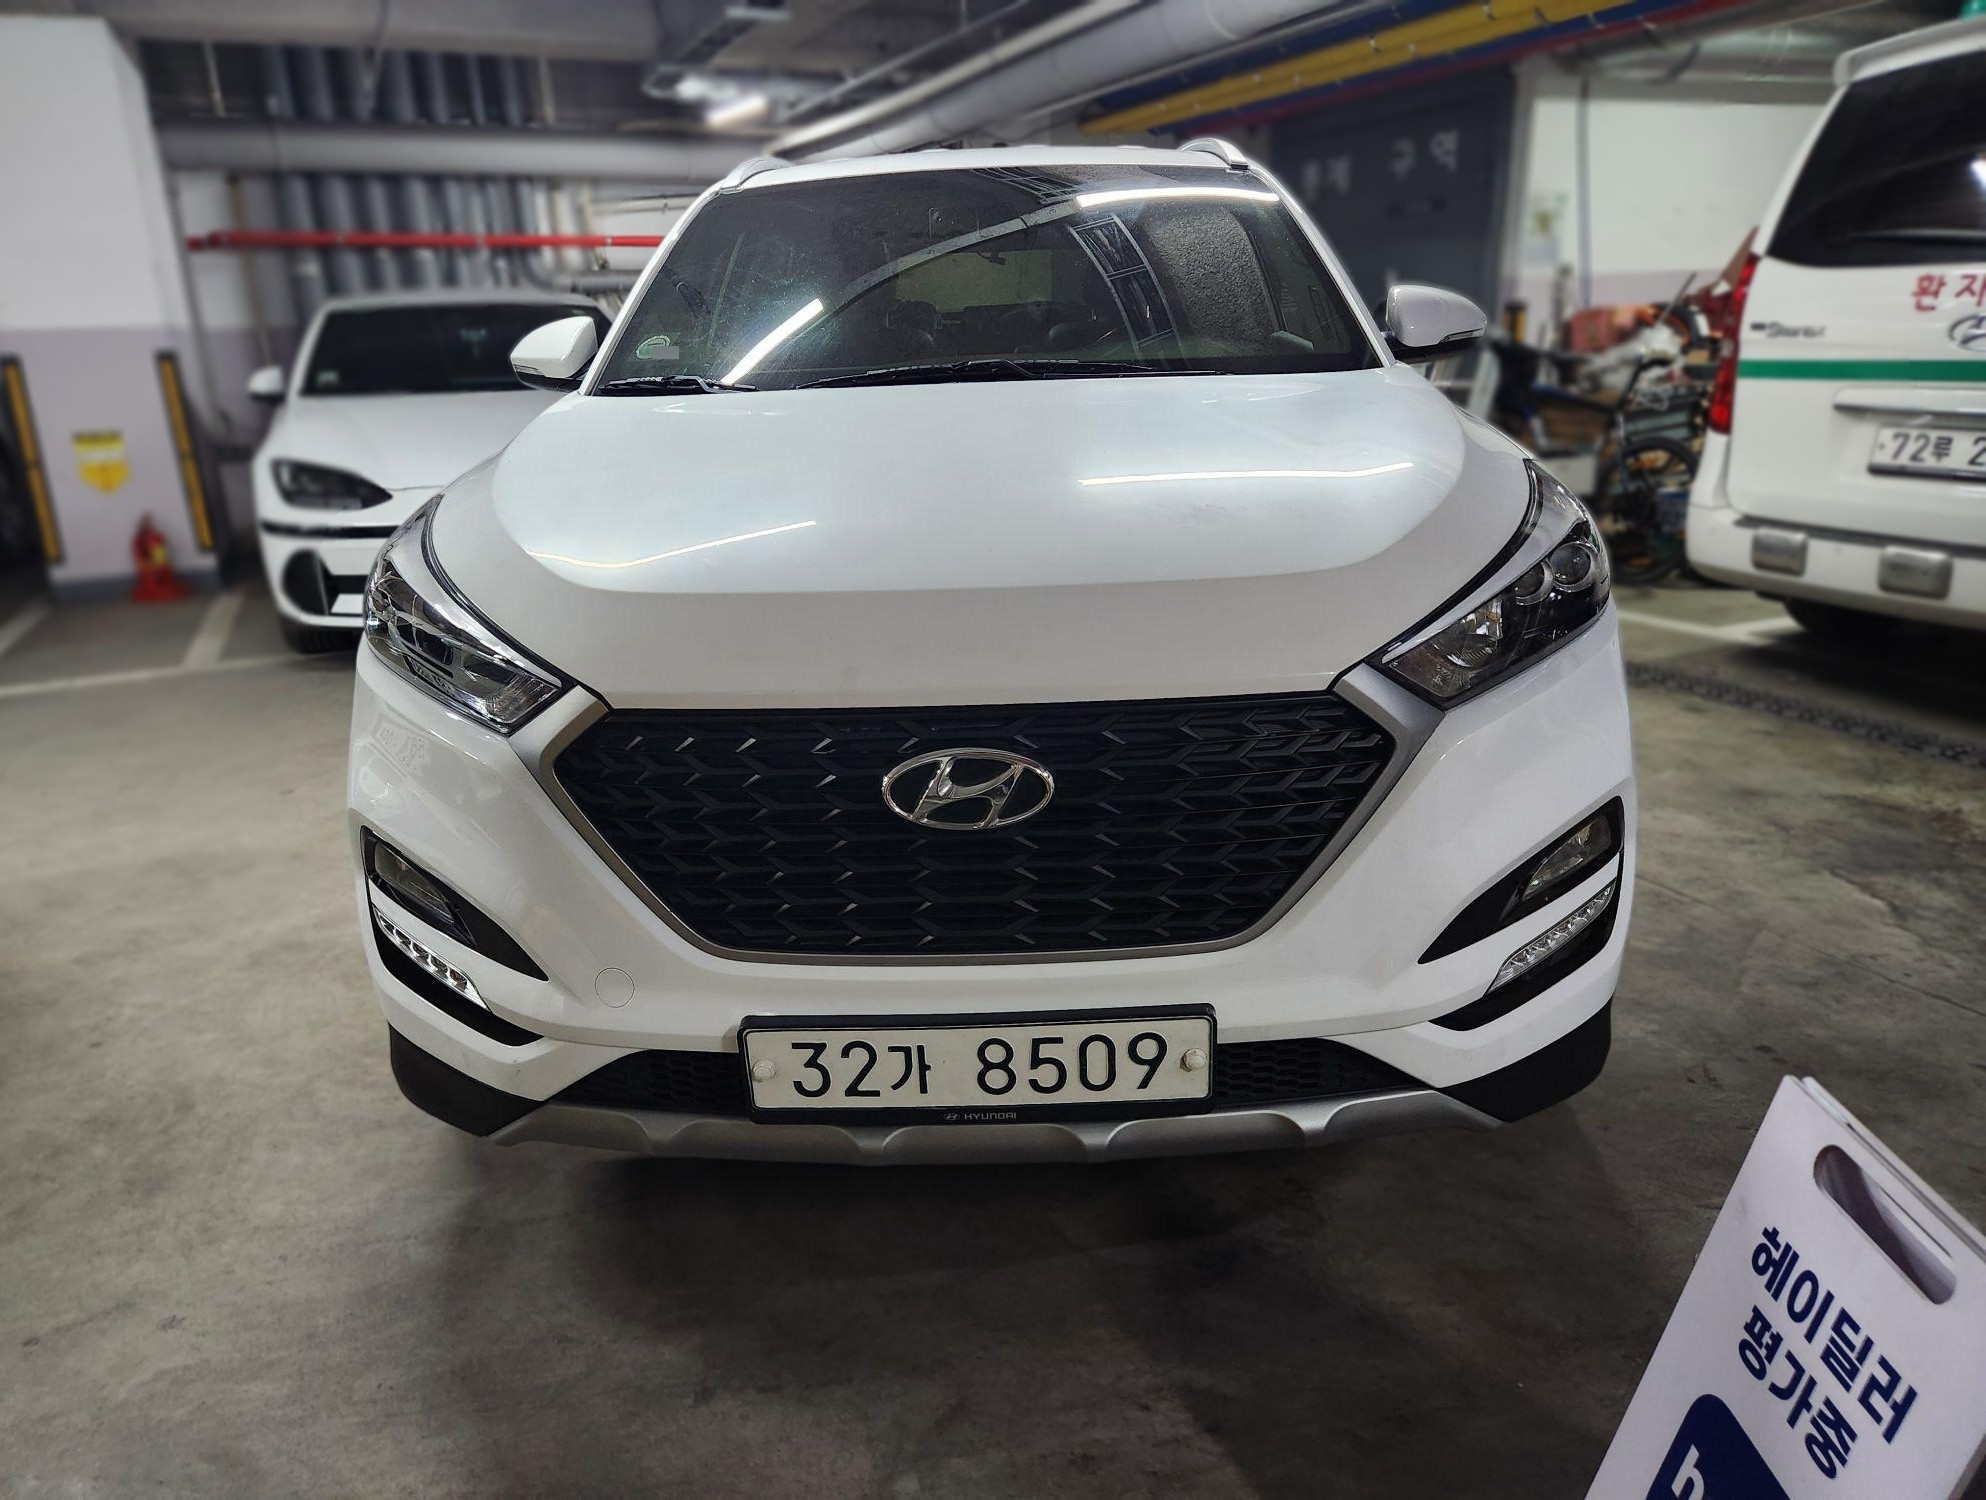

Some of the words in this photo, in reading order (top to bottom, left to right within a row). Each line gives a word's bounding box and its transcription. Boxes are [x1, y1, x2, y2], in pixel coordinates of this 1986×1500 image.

[790, 1039, 932, 1099] 32가
[976, 1032, 1169, 1095] 8509
[964, 1111, 1018, 1121] HYUNDAI
[1738, 1305, 1859, 1479] 평가중
[1751, 1226, 1920, 1446] 헤이딜러
